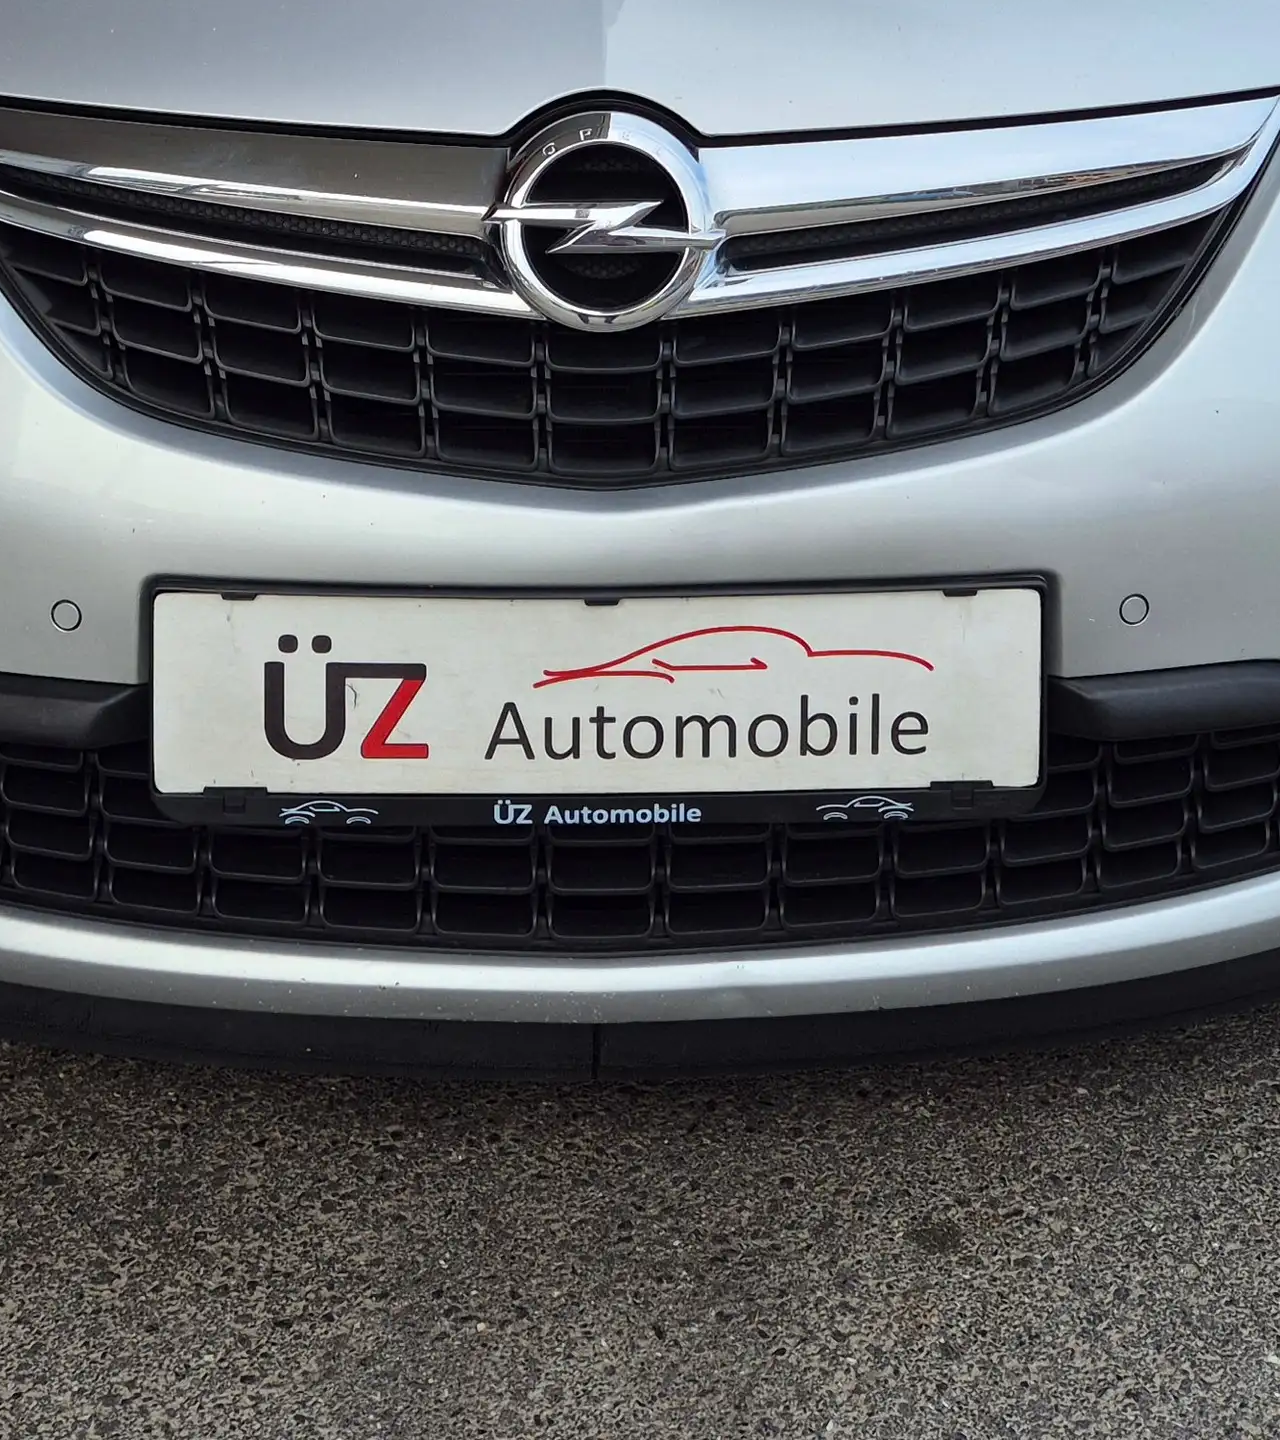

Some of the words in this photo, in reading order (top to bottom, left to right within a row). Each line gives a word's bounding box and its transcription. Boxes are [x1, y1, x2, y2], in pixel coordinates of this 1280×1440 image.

[264, 635, 429, 760] ÜZ
[485, 694, 929, 760] Automobile
[493, 799, 533, 825] ÜZ
[544, 803, 702, 825] Automobile
